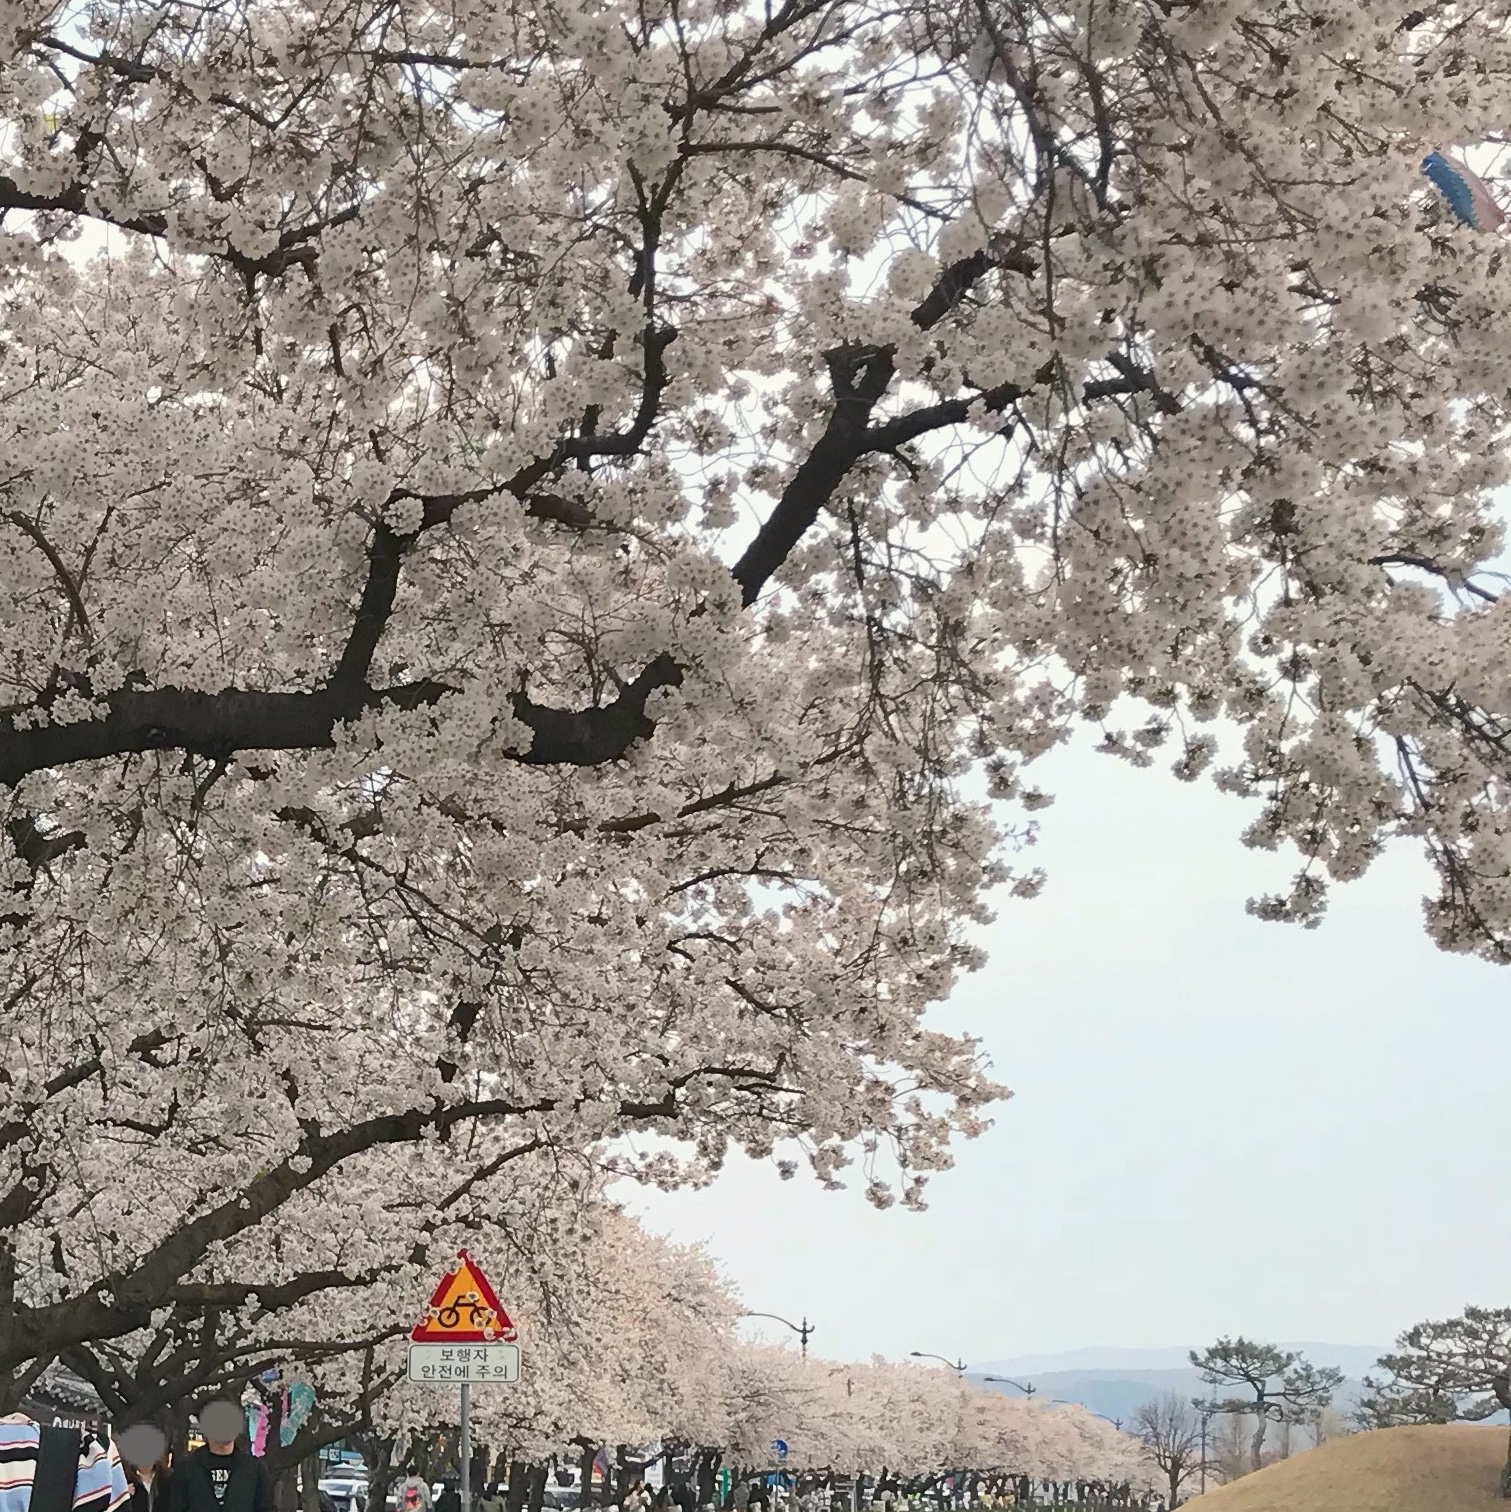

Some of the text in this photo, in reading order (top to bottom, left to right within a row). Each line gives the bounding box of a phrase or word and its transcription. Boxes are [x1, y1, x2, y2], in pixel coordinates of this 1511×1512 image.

[440, 1348, 489, 1363] 보행자
[421, 1364, 508, 1380] 안전에 주의
